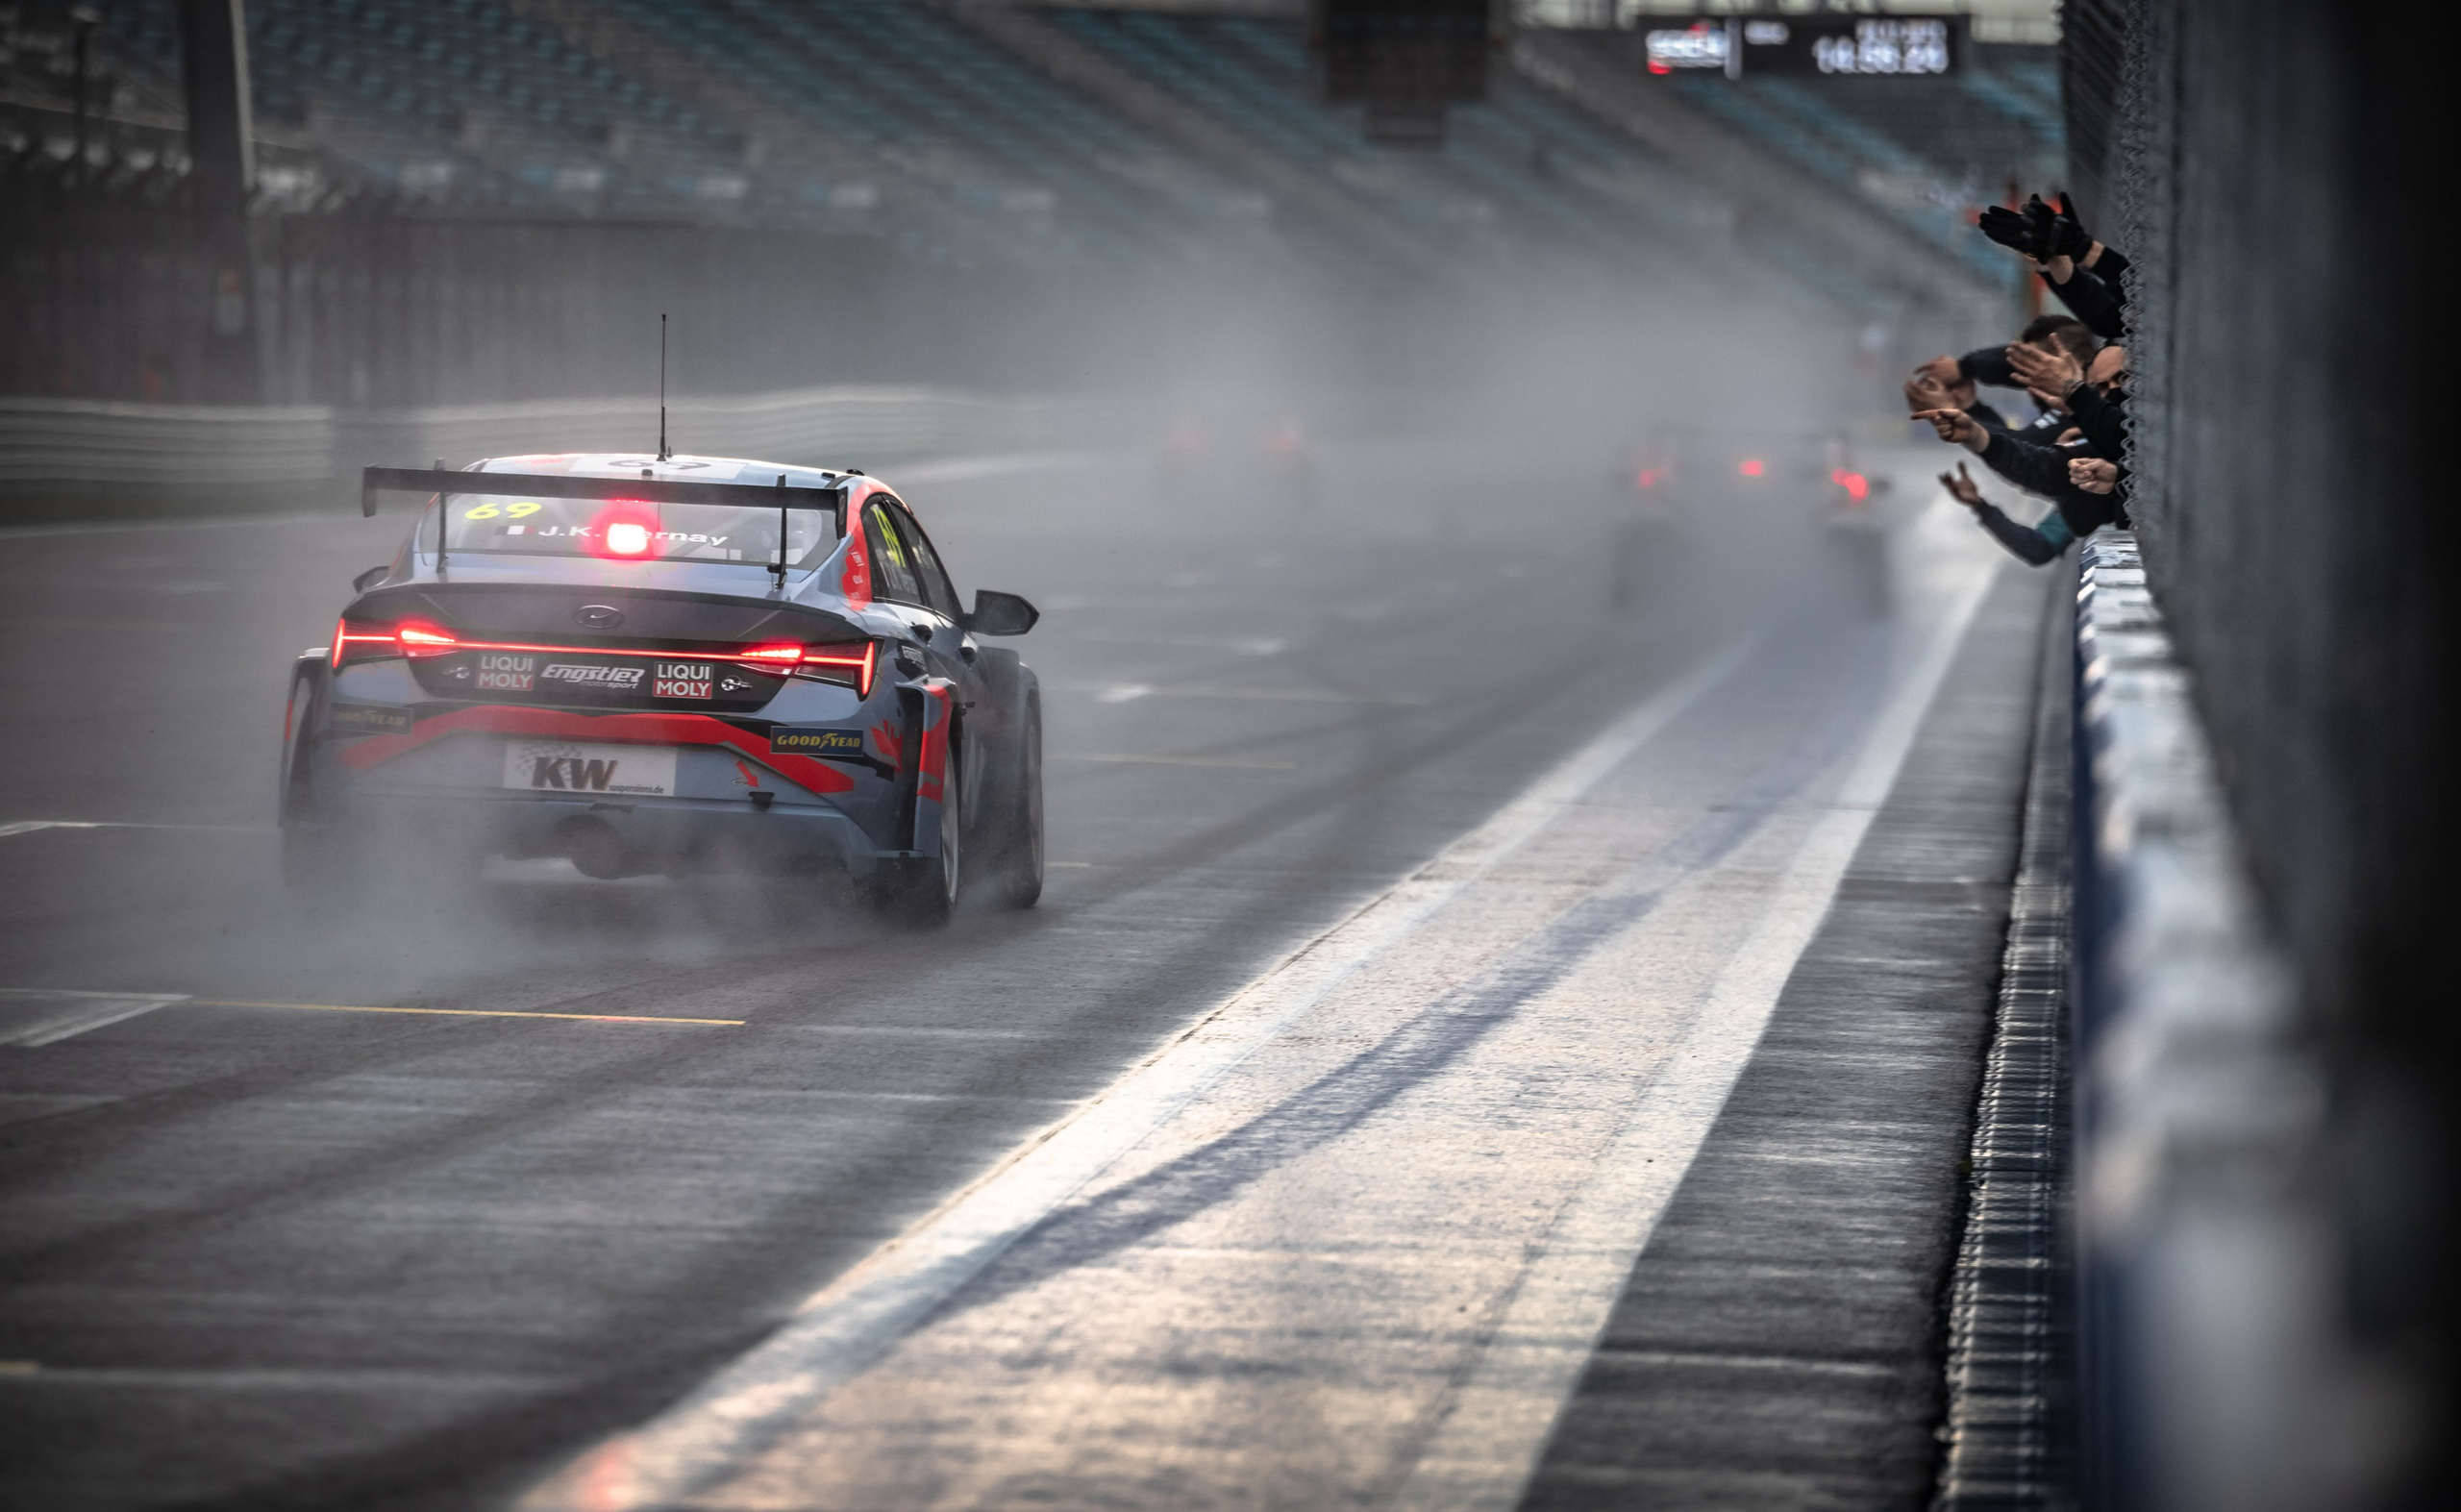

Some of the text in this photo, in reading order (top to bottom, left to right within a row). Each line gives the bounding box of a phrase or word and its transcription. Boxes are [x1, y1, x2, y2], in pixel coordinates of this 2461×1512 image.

[464, 502, 541, 519] 69
[538, 526, 728, 546] J.K. ernay
[481, 656, 534, 672] LIQUI
[658, 664, 710, 680] LIQUI
[479, 672, 533, 688] MOLY
[579, 681, 638, 689] motorsport
[656, 681, 710, 697] MOLY
[532, 756, 664, 794] KW suspensions.de
